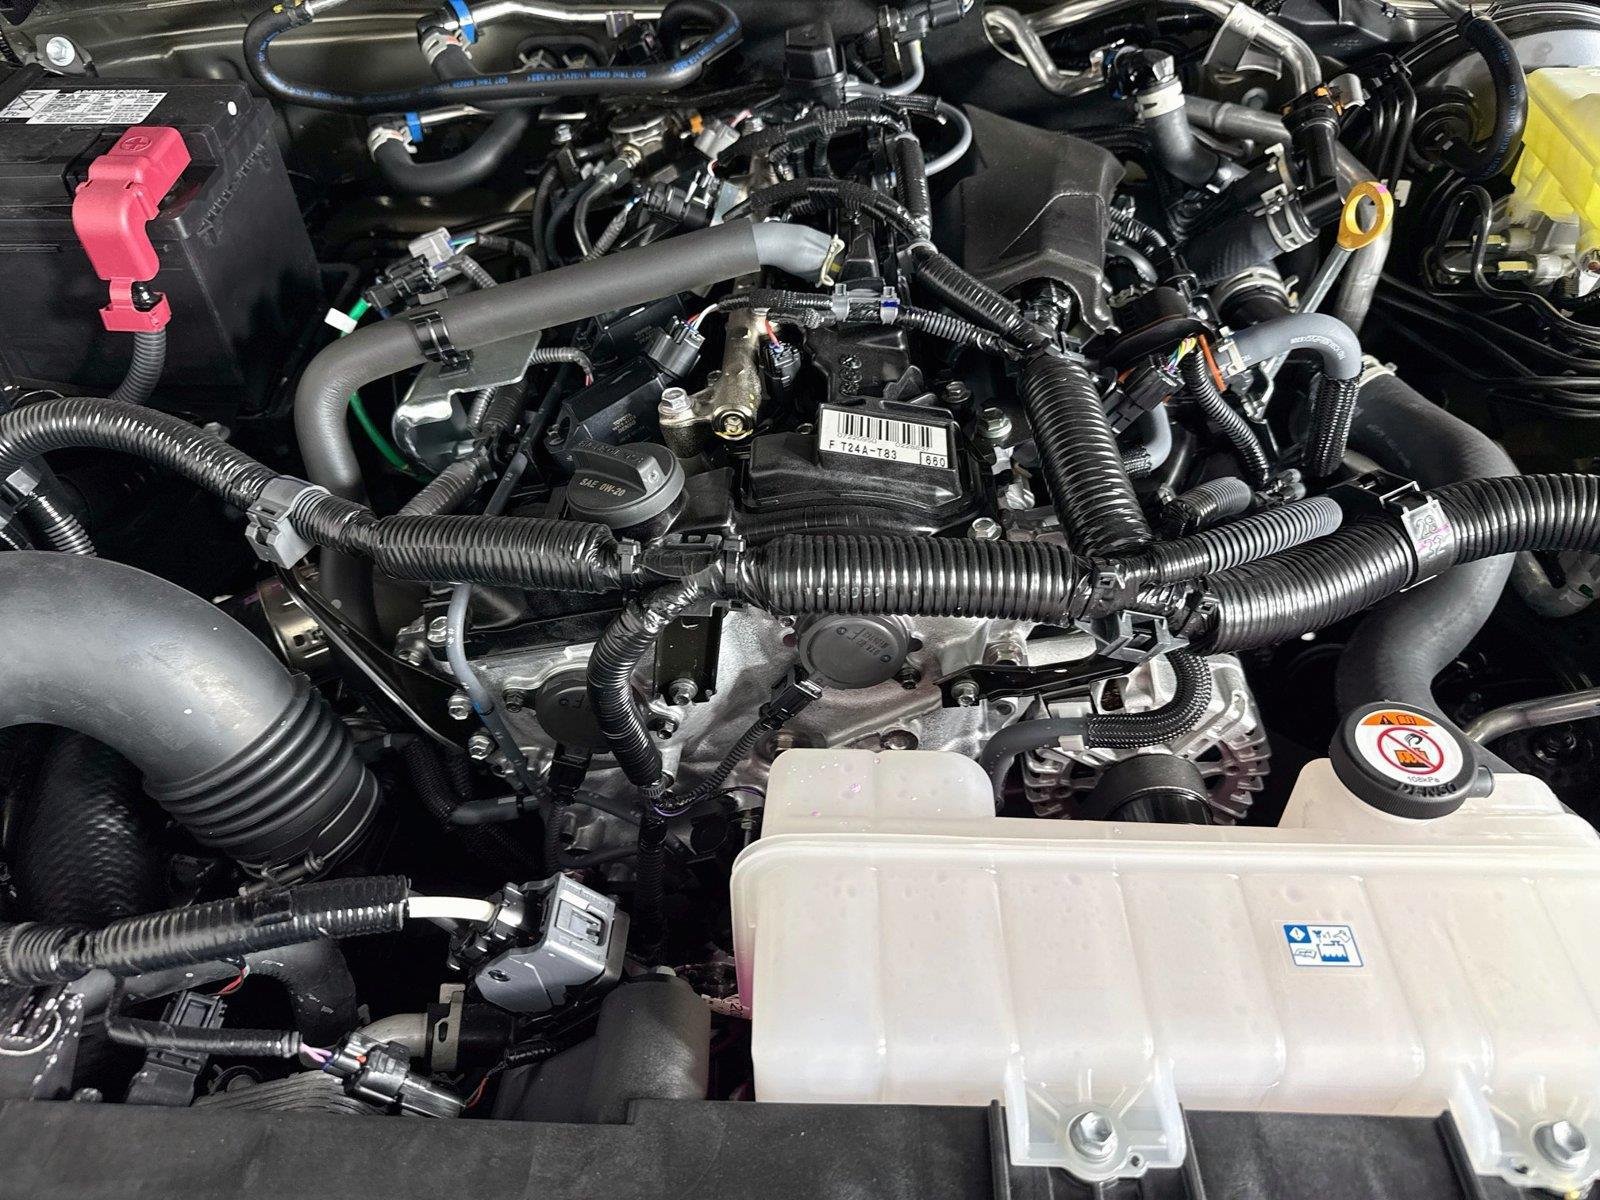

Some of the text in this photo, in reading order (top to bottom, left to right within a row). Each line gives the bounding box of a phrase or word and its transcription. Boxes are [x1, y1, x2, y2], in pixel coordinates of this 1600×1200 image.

[828, 440, 898, 460] F T24A-T83
[579, 478, 627, 497] SAE 0W-20
